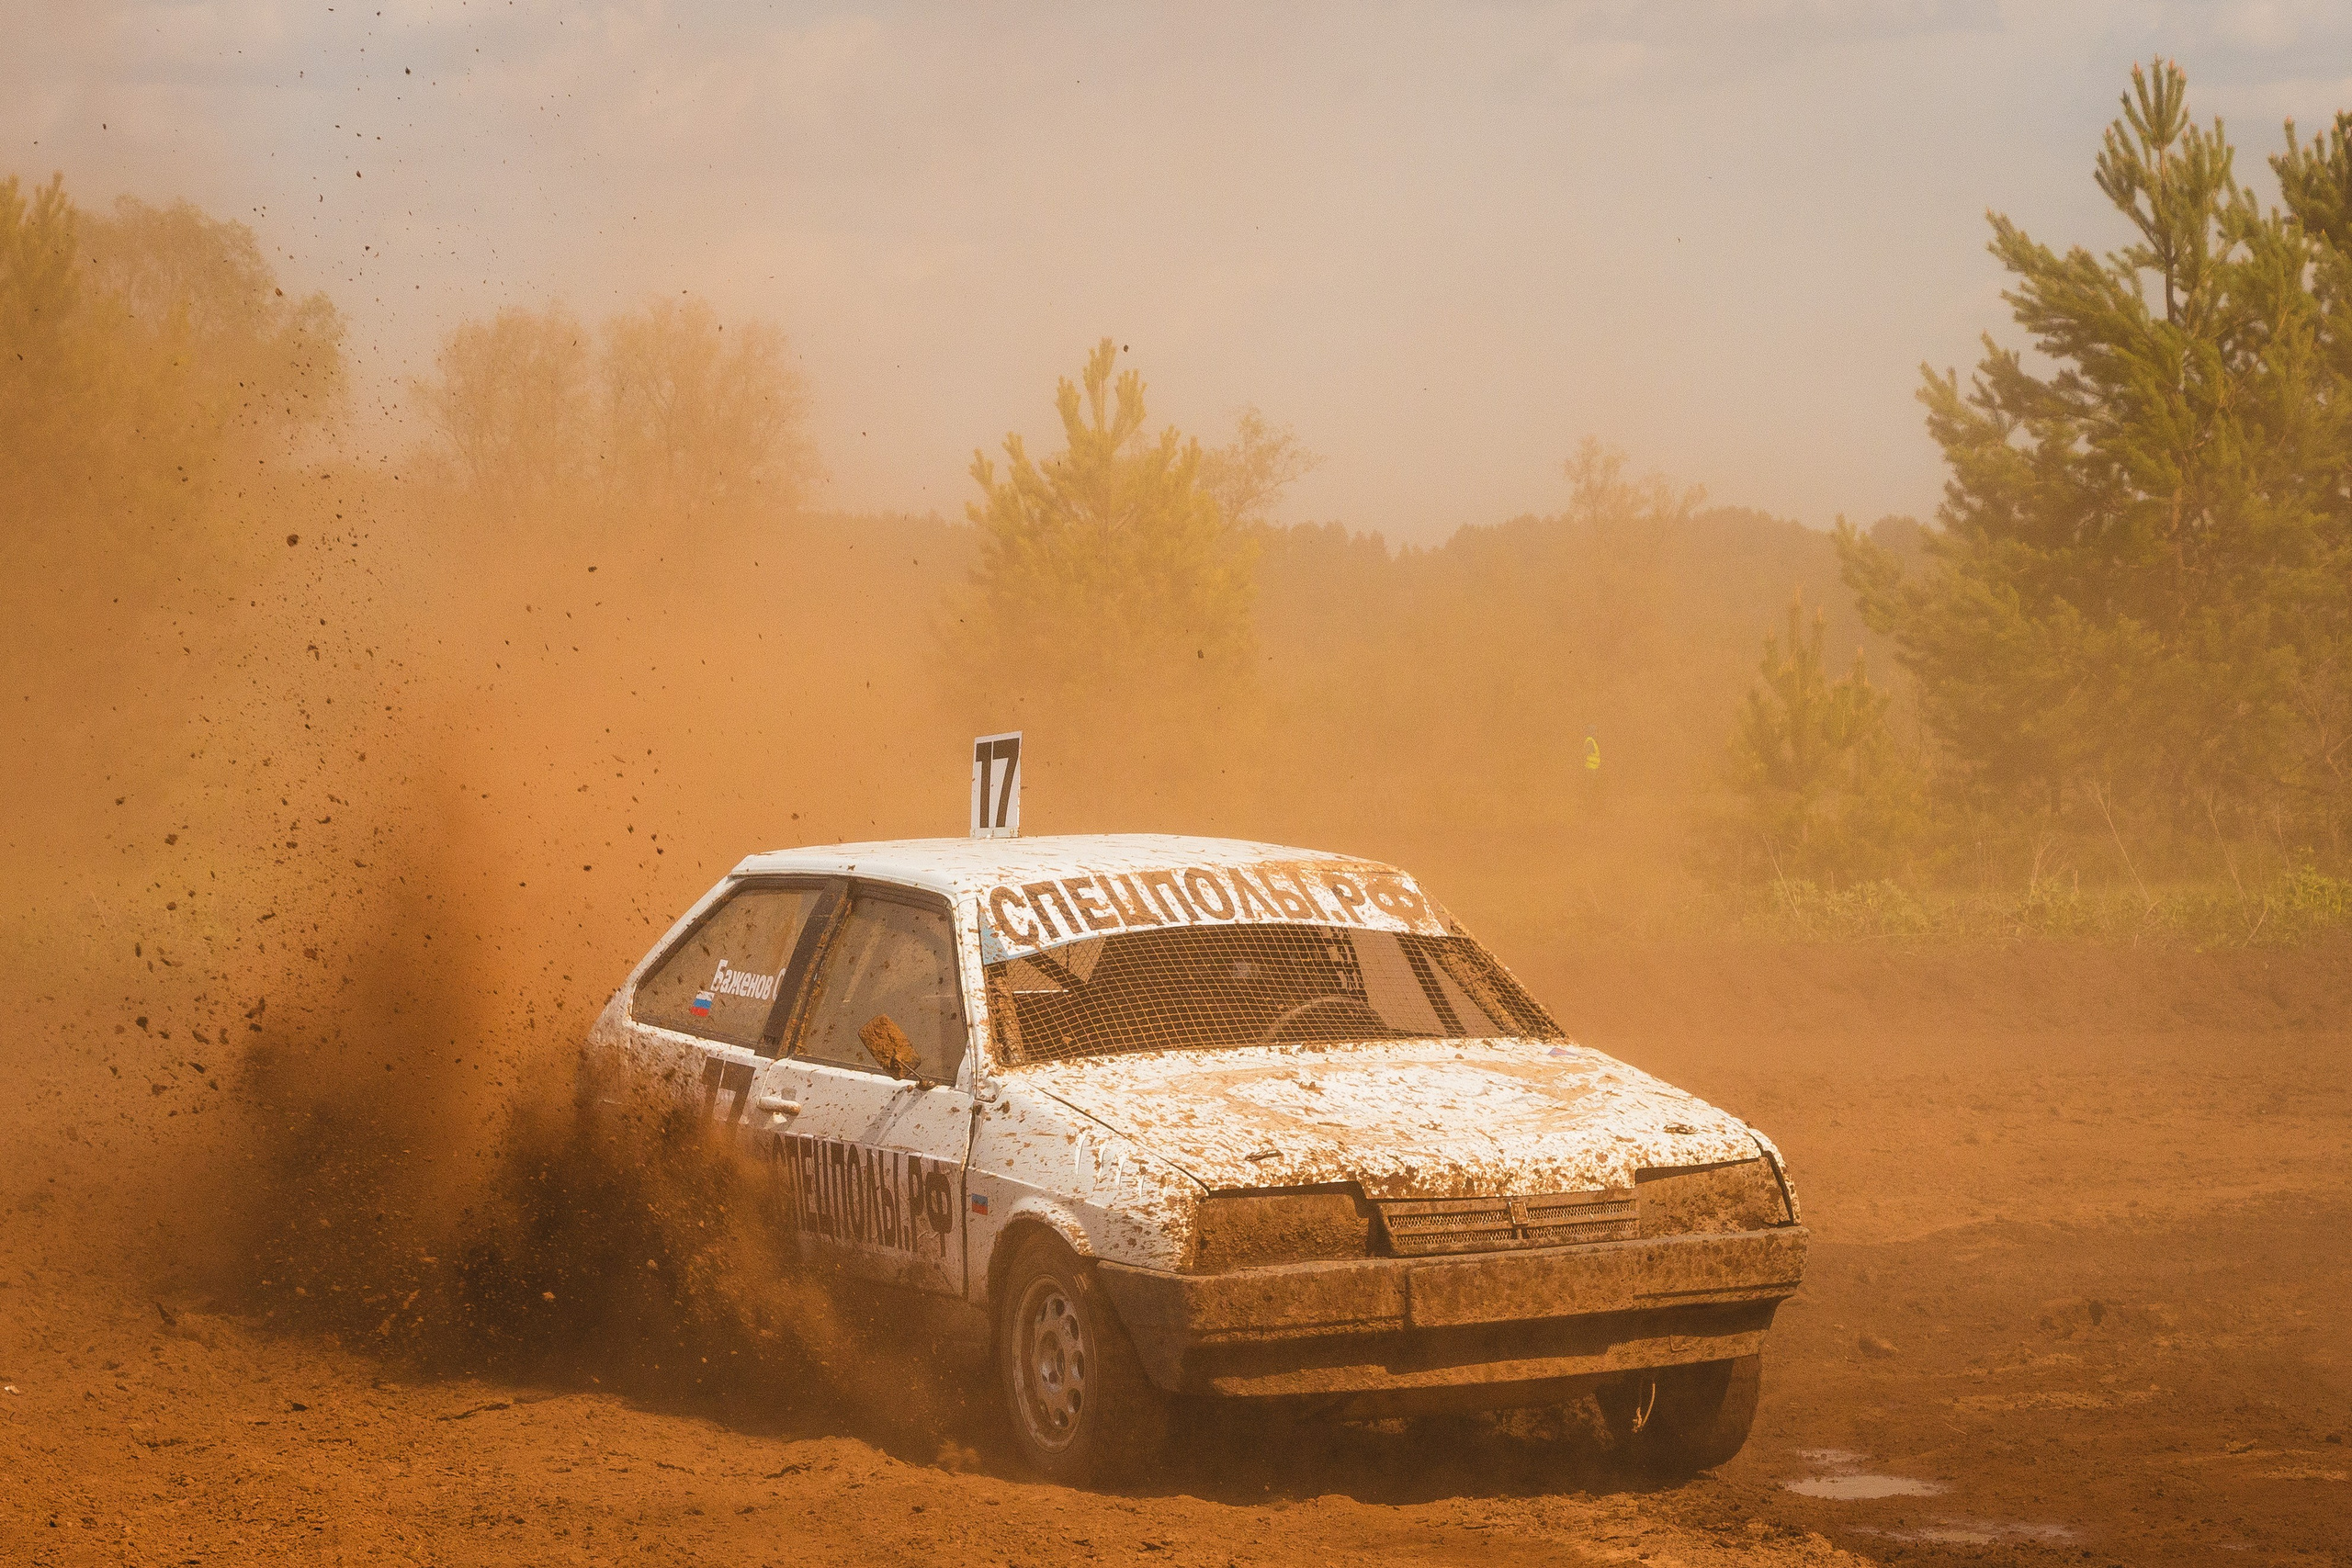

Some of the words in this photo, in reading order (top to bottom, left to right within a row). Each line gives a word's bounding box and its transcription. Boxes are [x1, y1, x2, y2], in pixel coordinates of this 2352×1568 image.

[976, 738, 1020, 829] 17
[989, 866, 1428, 946] СПЕЦПОЛЫ.РФ
[710, 959, 774, 1000] Баженов
